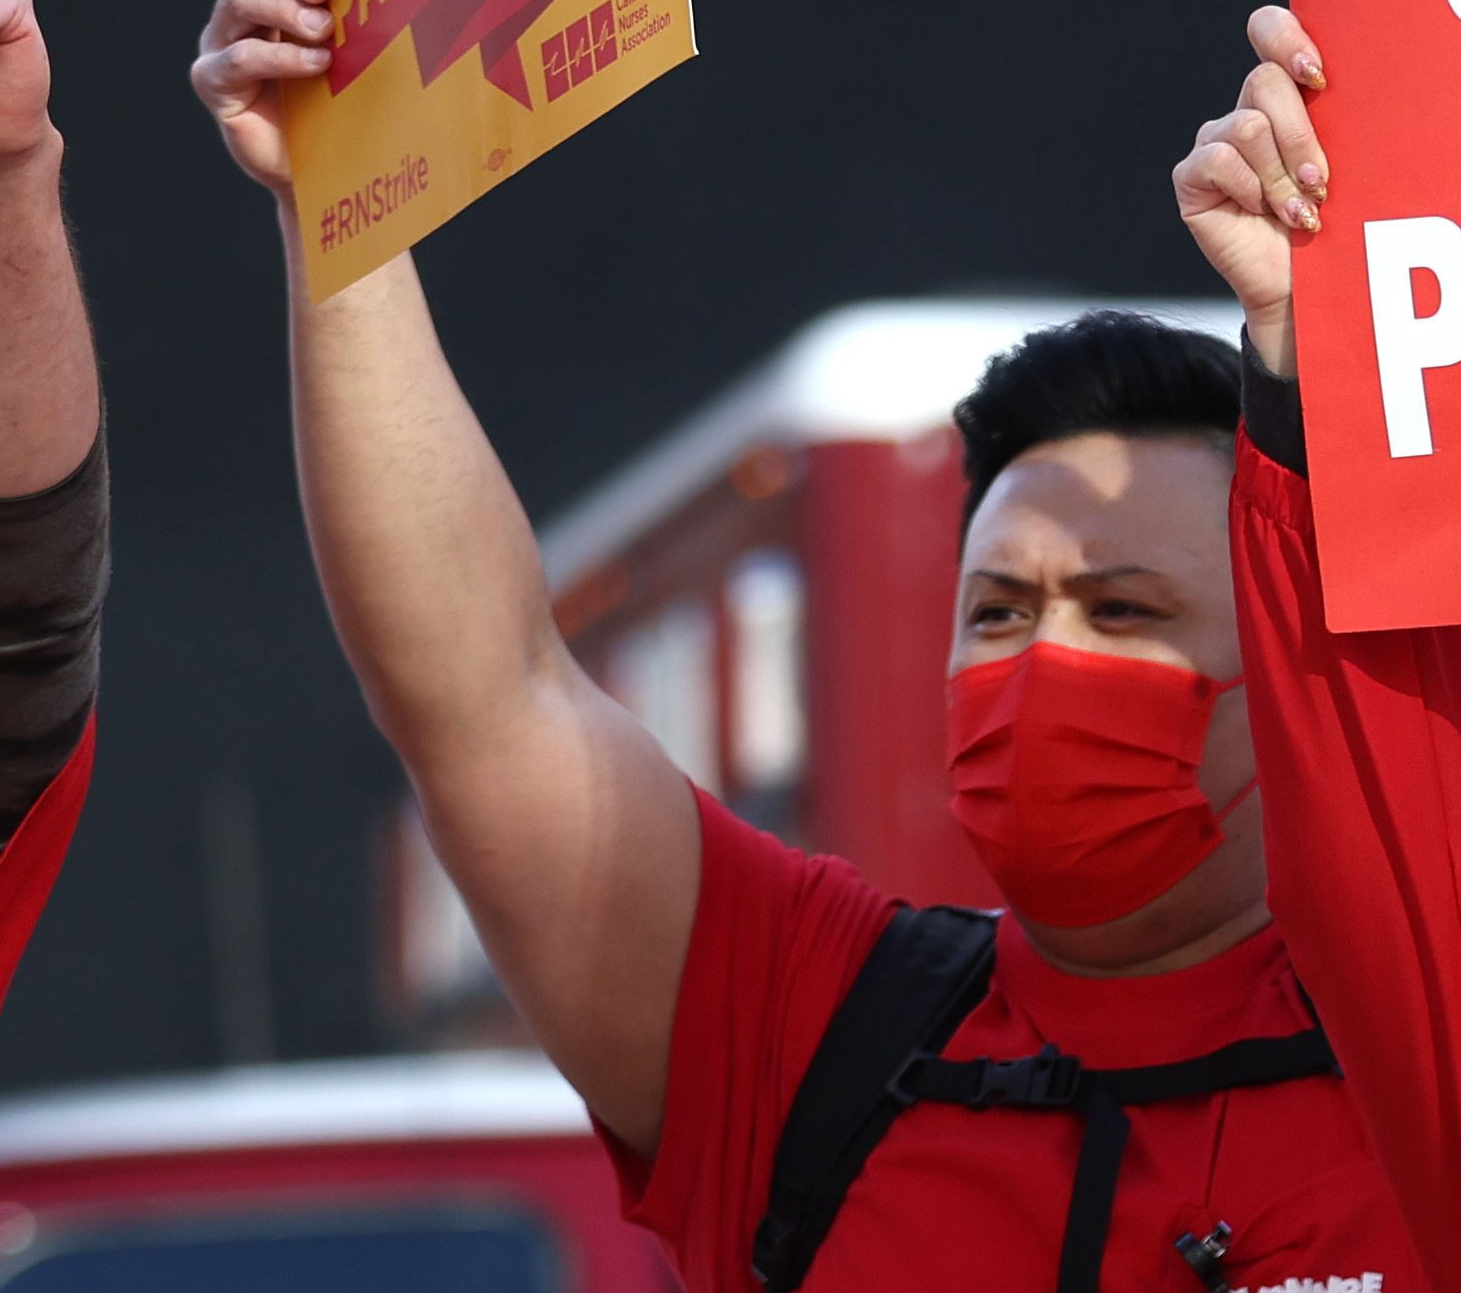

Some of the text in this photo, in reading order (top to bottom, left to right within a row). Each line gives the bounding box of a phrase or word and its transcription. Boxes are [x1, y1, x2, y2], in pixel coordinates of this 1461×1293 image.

[619, 4, 649, 33] Nurses
[621, 12, 671, 56] Association
[319, 153, 429, 254] #RNStrike
